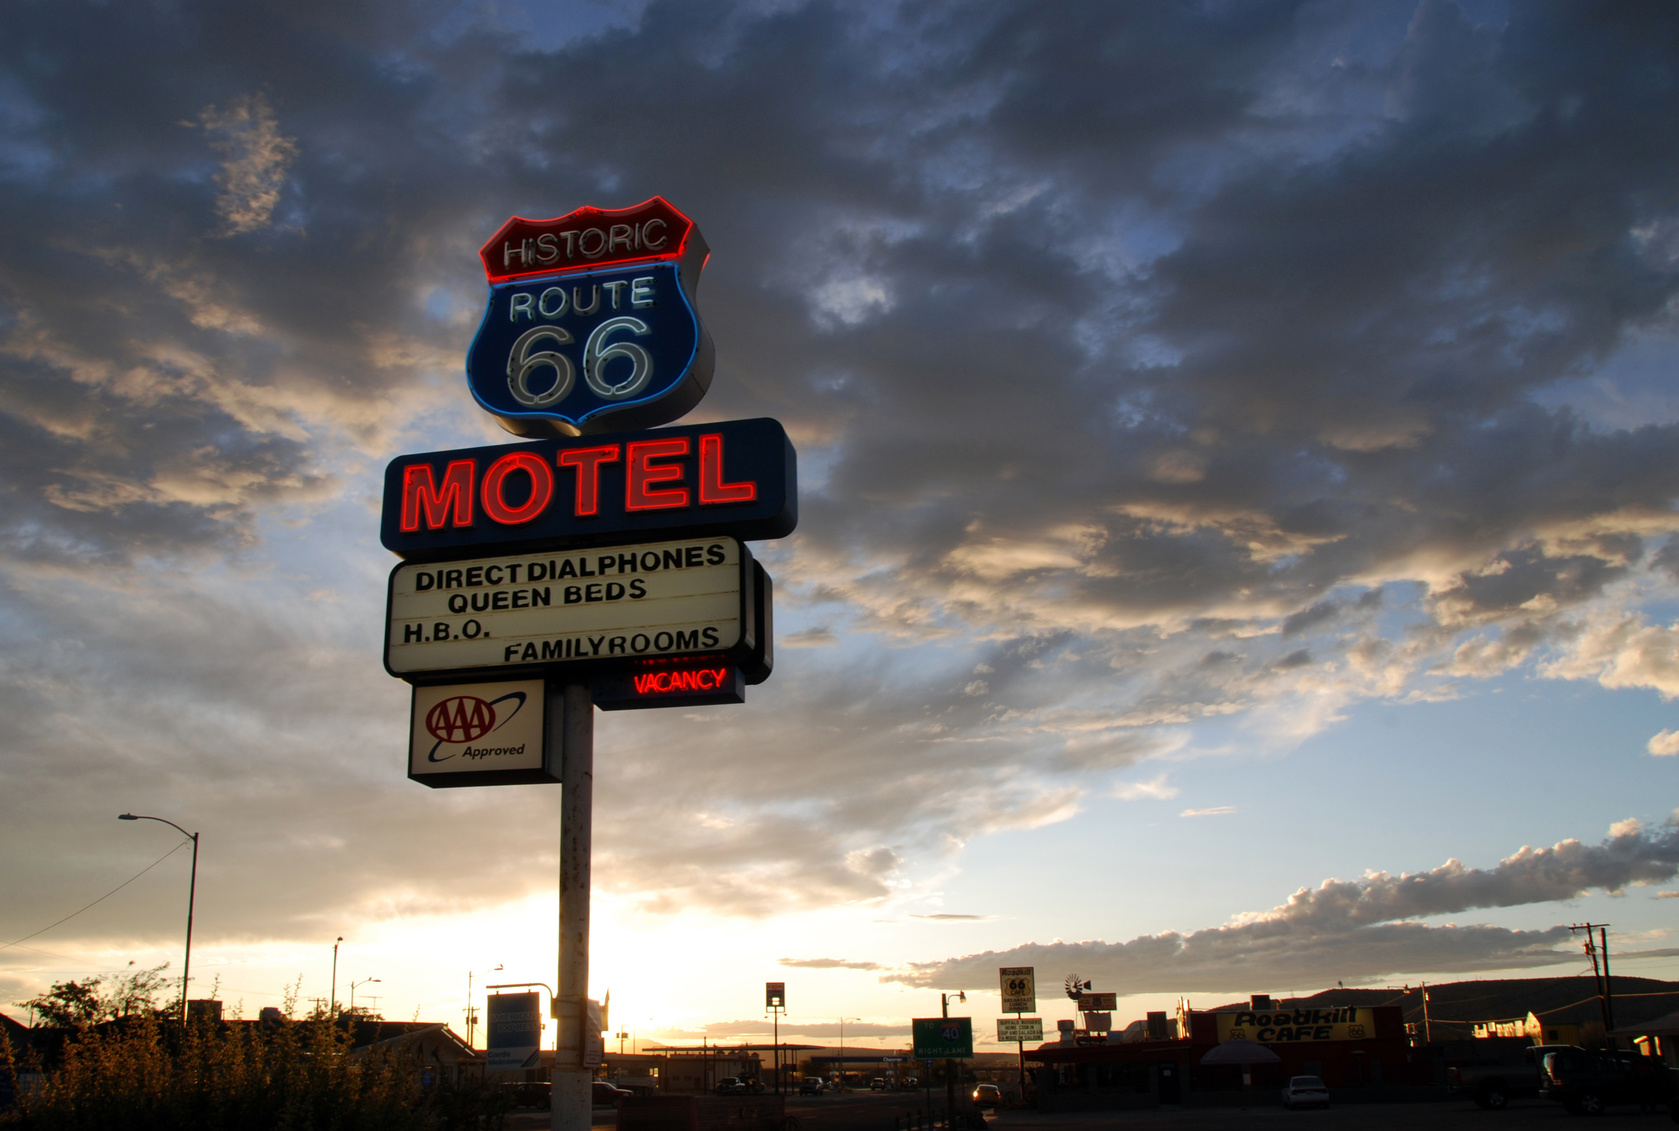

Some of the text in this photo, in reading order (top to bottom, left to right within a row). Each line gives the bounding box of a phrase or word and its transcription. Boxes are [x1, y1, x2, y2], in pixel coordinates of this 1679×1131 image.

[503, 218, 668, 269] HISTORIC
[509, 276, 657, 323] ROUTE
[506, 316, 654, 409] 66
[400, 432, 758, 532] MOTEL
[448, 578, 647, 613] QUEEN BEDS
[404, 619, 491, 643] H.B.O.
[634, 667, 727, 694] VACANCY
[430, 699, 489, 742] AAA
[462, 743, 525, 760] Approved
[1009, 979, 1026, 990] 66
[1234, 1007, 1358, 1026] Roadkill
[942, 1028, 959, 1040] 40
[1257, 1025, 1333, 1042] CAFE
[1351, 1028, 1363, 1036] 66
[488, 1050, 511, 1058] Cards
[918, 1047, 943, 1055] RIGHT
[488, 1058, 524, 1066] Welcome
